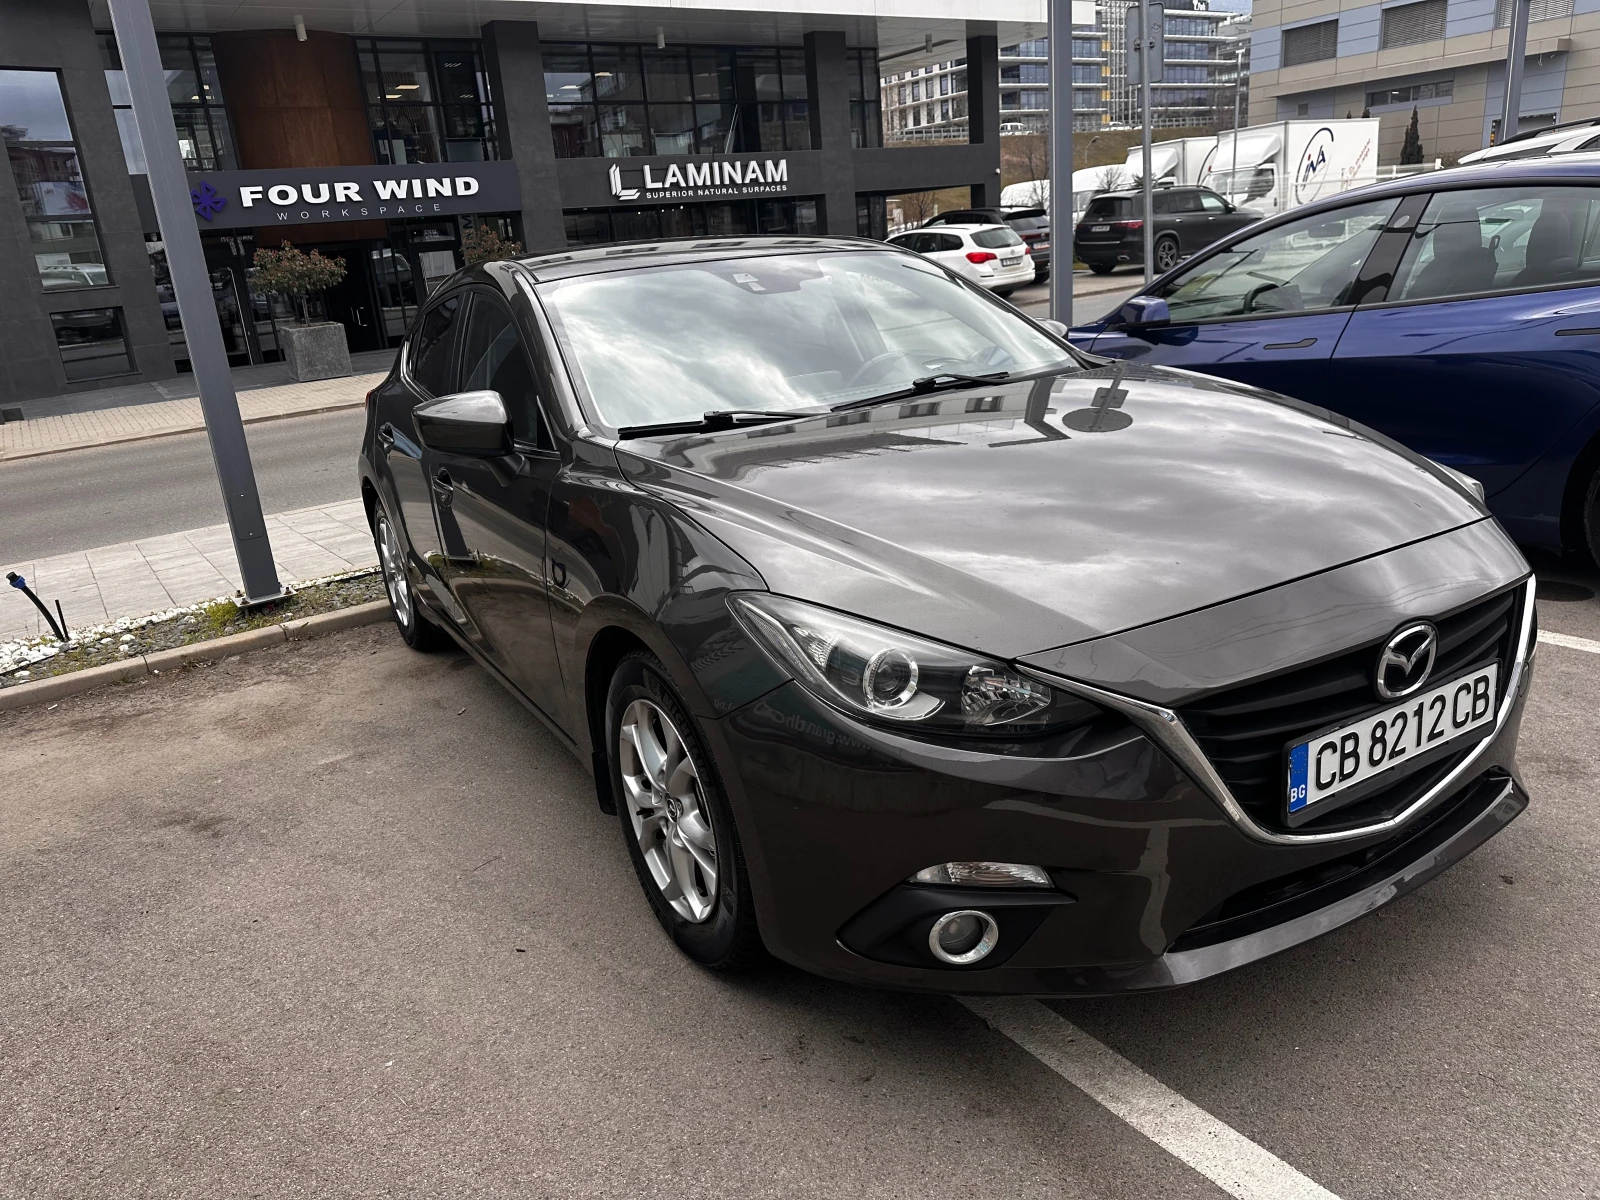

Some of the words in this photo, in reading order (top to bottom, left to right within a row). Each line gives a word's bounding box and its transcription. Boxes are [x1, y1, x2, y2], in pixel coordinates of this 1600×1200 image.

[643, 159, 788, 189] LAMINAM
[239, 181, 364, 208] FOUR
[373, 176, 480, 200] WIND
[646, 190, 694, 199] SUPERIOR
[697, 187, 739, 196] NATURAL
[742, 184, 788, 193] SURFACES
[276, 203, 441, 221] WORKSPACE
[1315, 732, 1360, 791] CB
[1368, 694, 1446, 767] 8212
[1452, 675, 1490, 728] CB
[1290, 784, 1306, 803] BG
